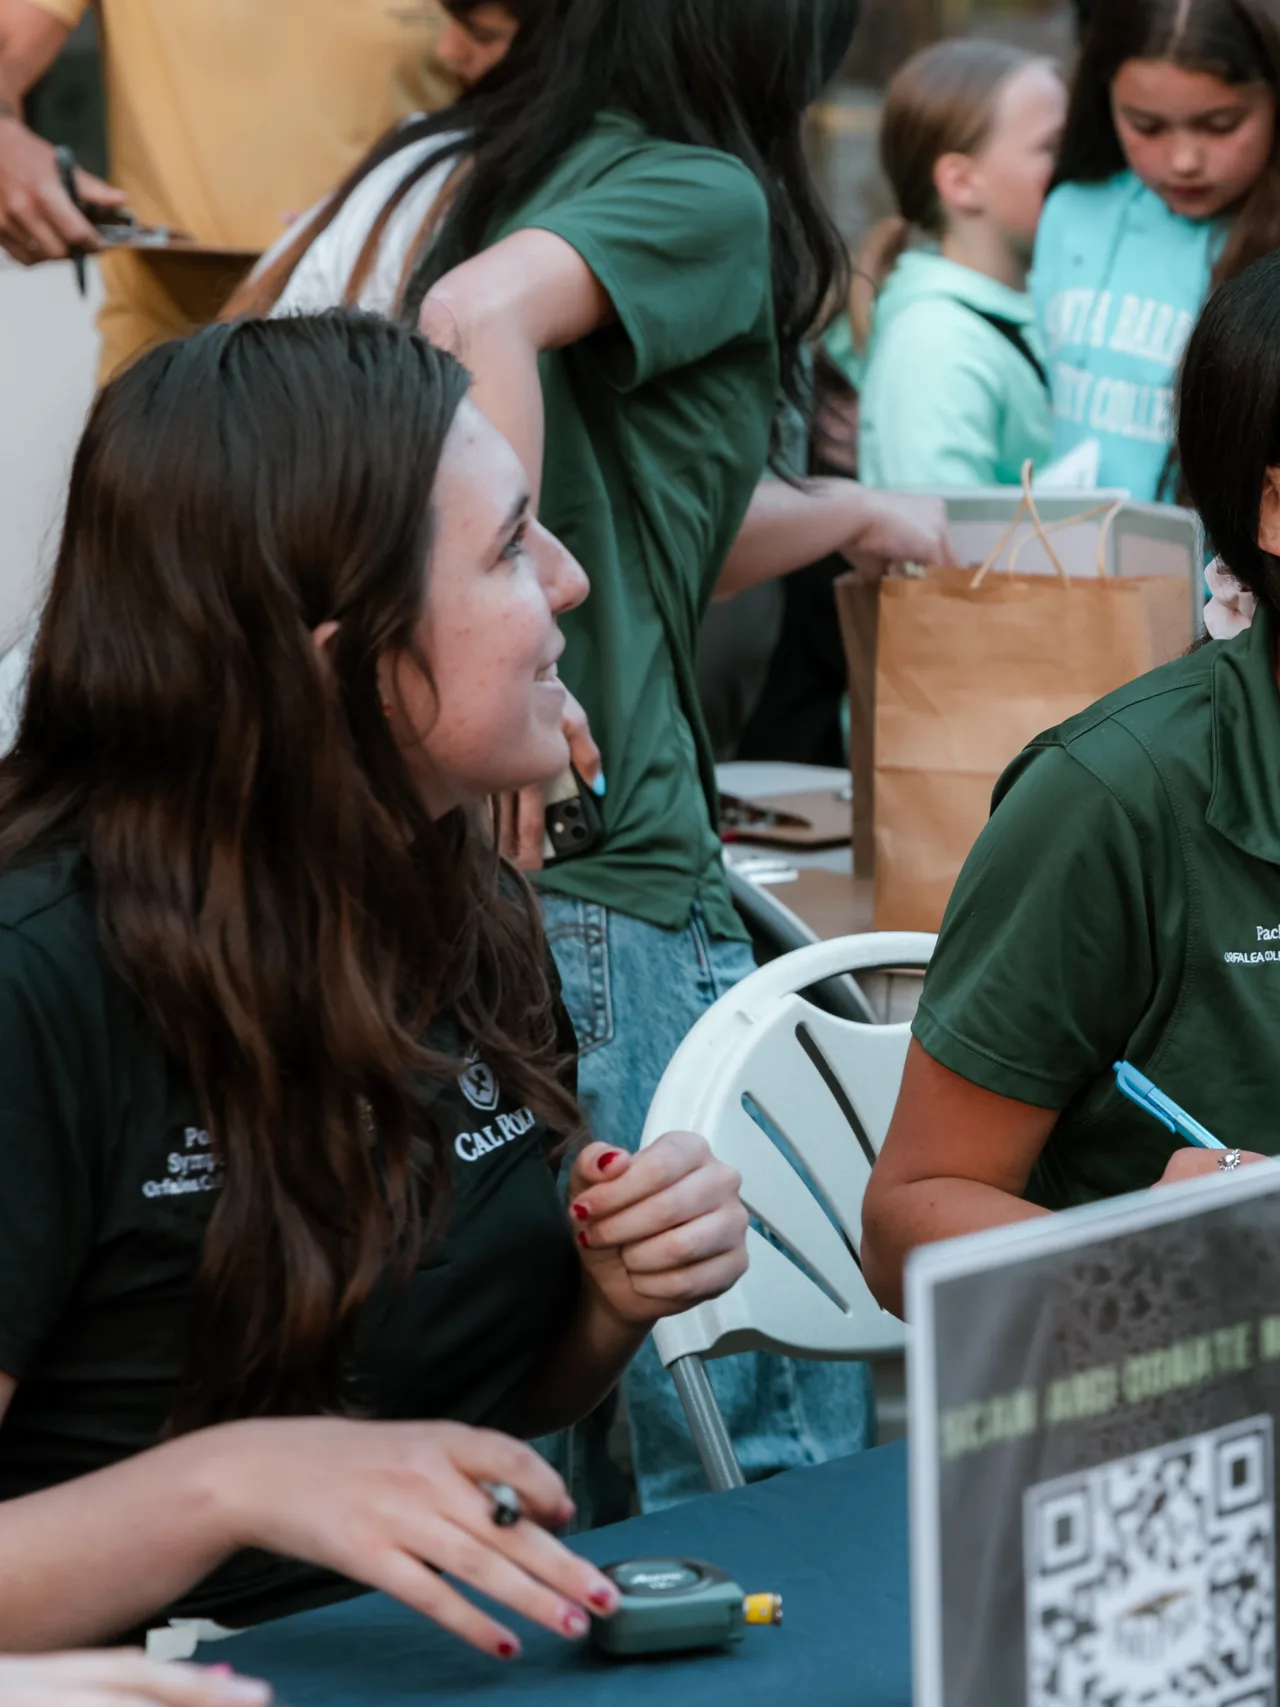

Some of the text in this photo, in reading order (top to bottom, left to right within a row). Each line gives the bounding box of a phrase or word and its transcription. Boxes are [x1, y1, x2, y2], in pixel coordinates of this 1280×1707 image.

[454, 1107, 535, 1162] CAL POL
[1122, 1322, 1252, 1404] DONATE
